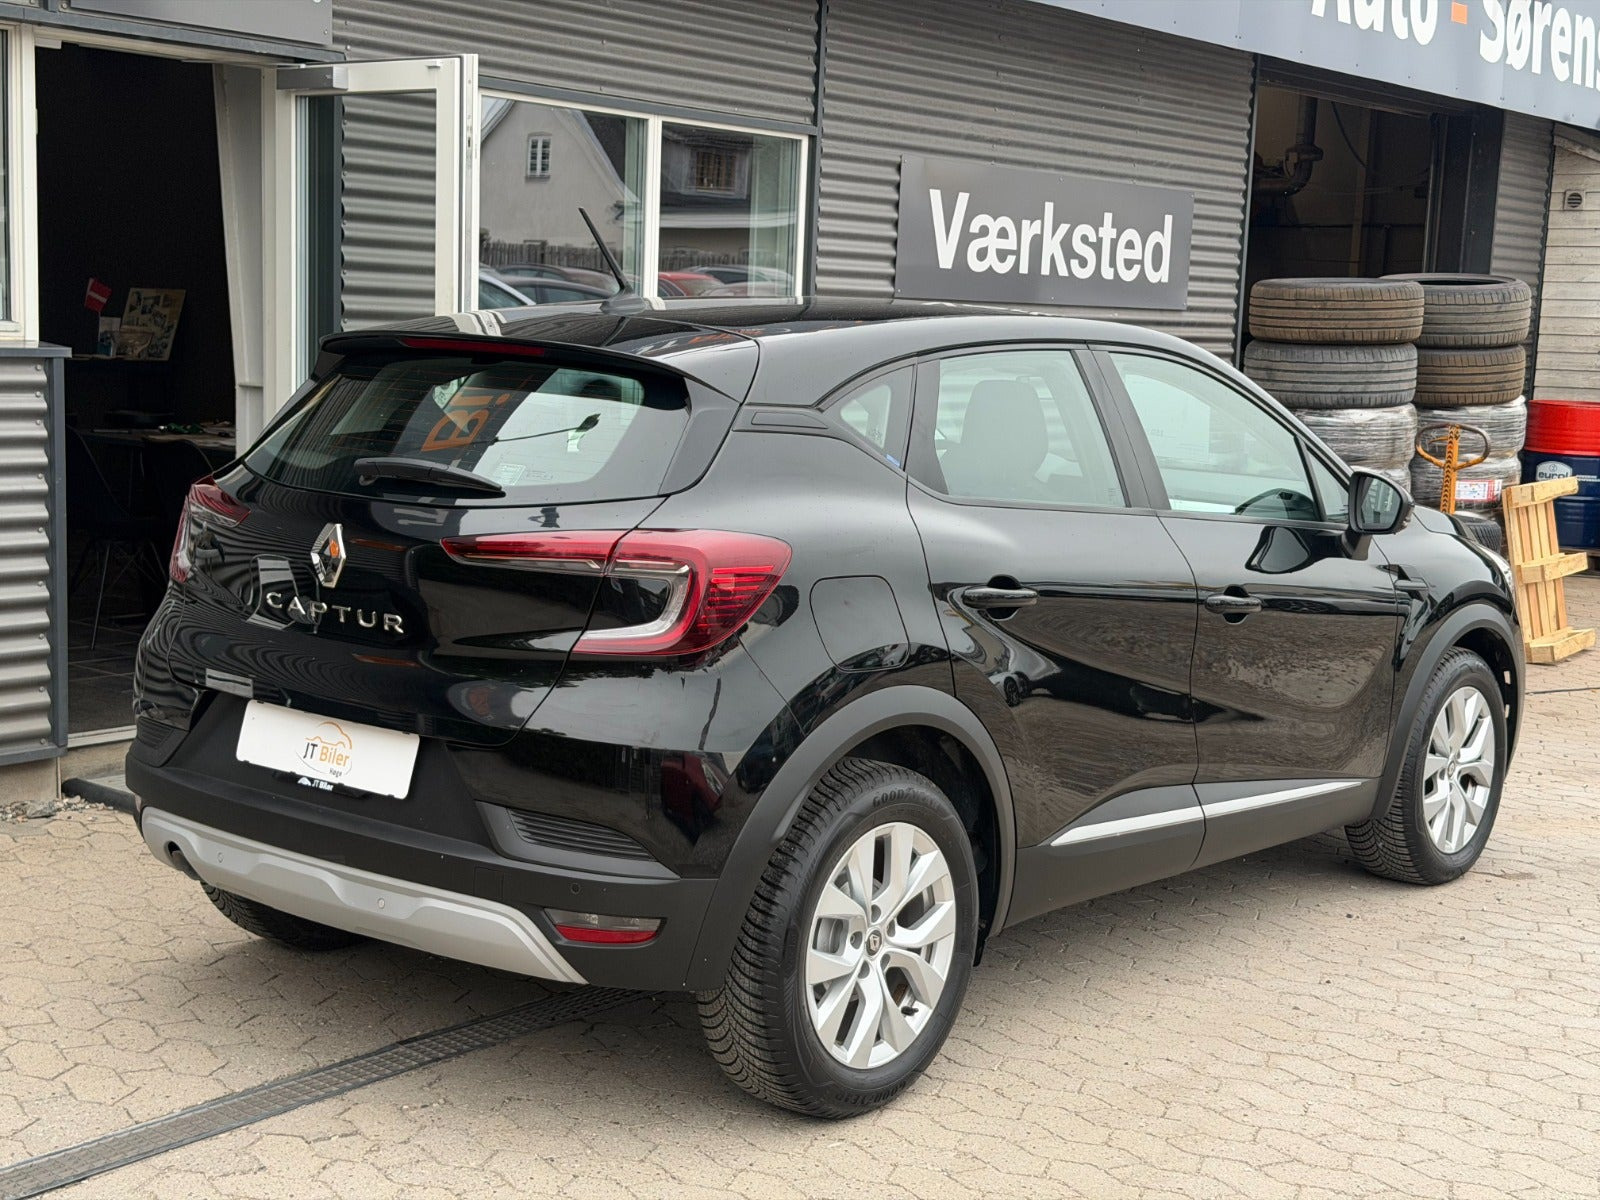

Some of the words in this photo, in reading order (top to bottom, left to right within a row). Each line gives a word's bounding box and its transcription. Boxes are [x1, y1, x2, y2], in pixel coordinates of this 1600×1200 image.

[1311, 0, 1438, 46] uto
[1479, 0, 1600, 92] Søren
[929, 188, 1173, 284] Værksted
[266, 591, 404, 635] CAPTUR
[303, 742, 318, 760] JT
[319, 745, 350, 767] Biler
